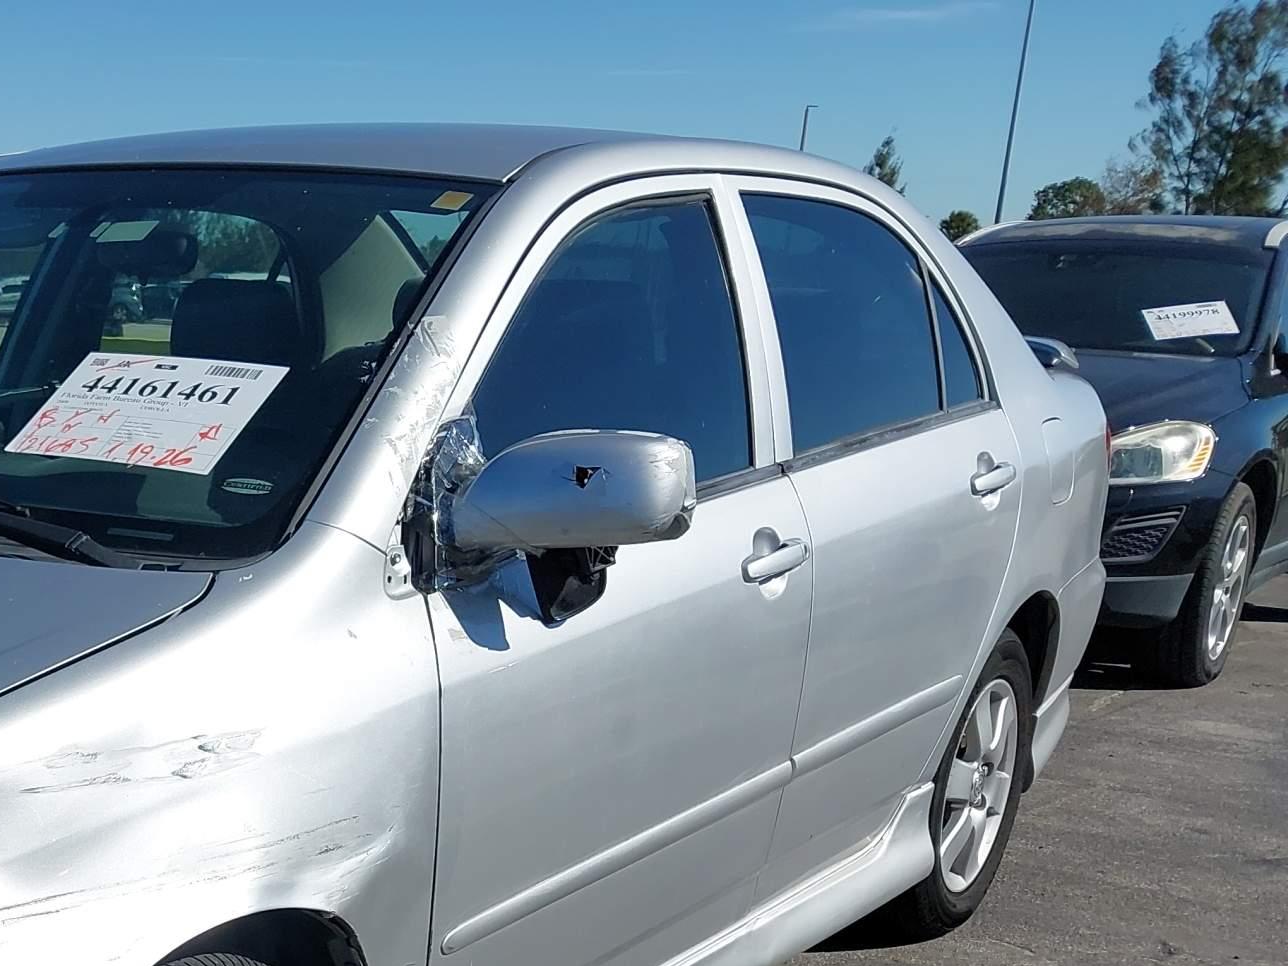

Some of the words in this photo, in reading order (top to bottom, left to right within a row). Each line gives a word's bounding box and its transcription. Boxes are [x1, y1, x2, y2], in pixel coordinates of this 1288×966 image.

[1155, 308, 1220, 320] 44199978
[81, 375, 240, 406] 44161461
[60, 392, 89, 400] Florida
[113, 395, 141, 403] Bureau
[143, 398, 169, 407] Group
